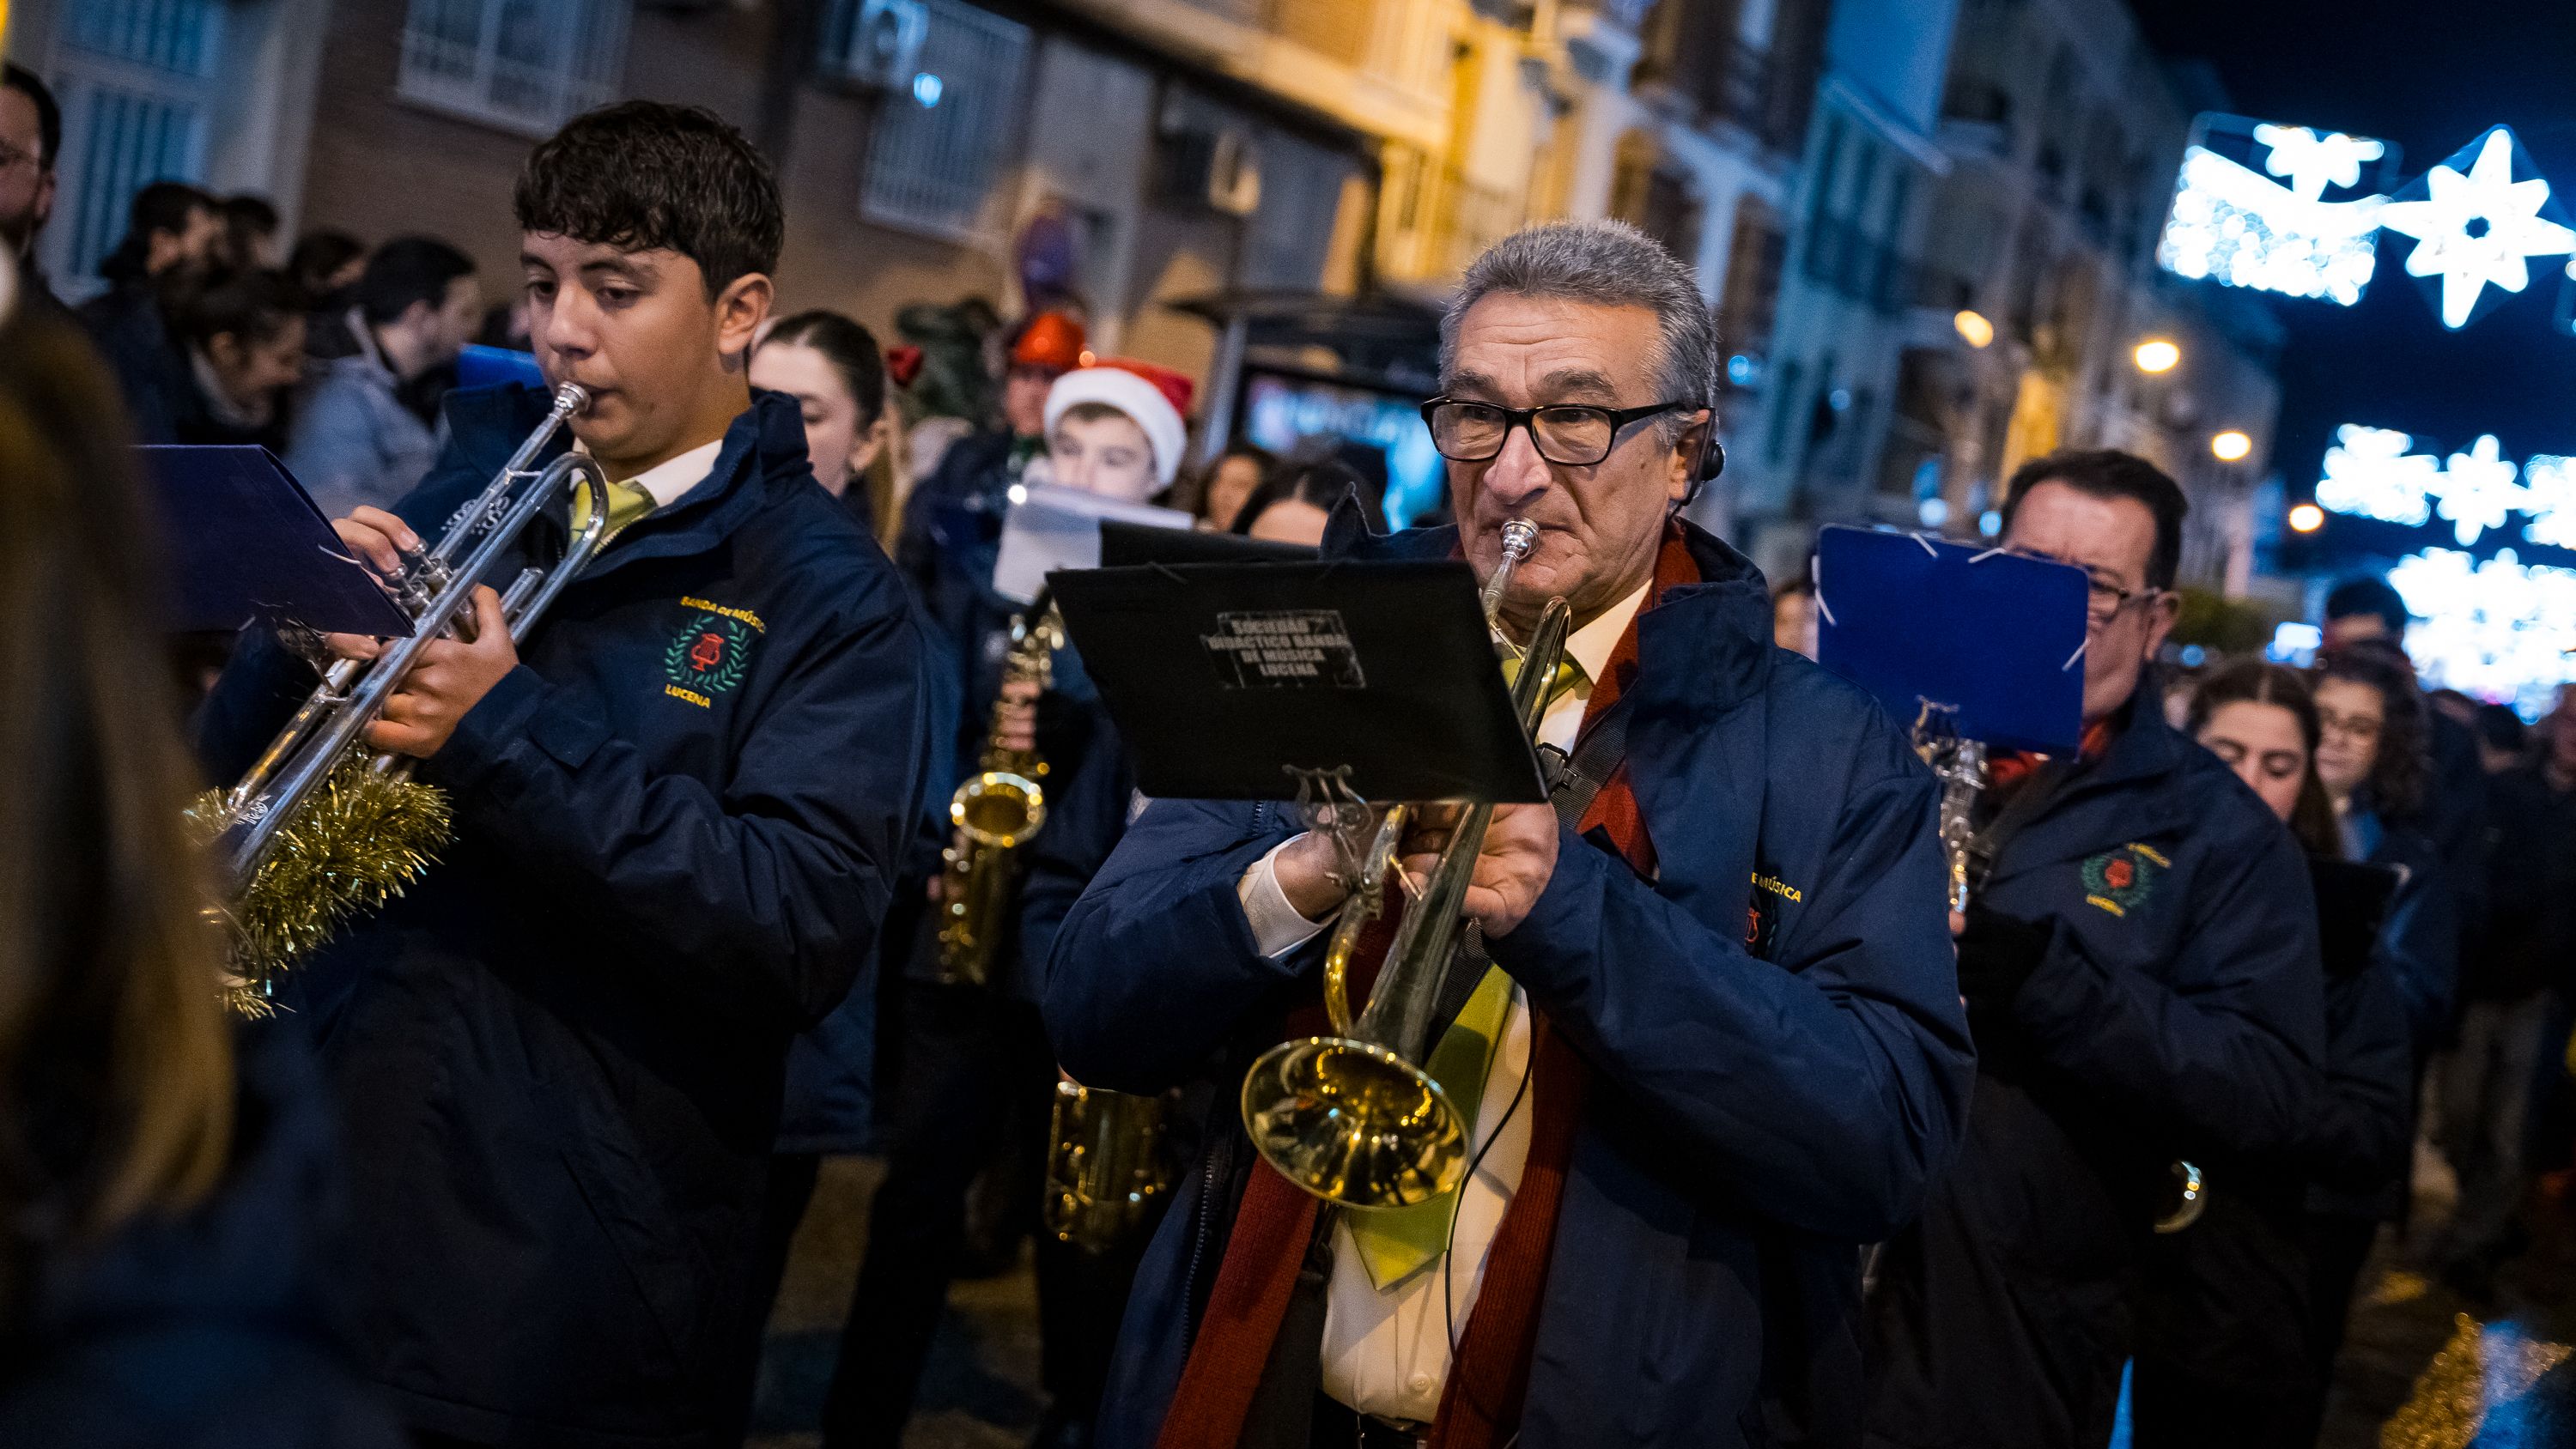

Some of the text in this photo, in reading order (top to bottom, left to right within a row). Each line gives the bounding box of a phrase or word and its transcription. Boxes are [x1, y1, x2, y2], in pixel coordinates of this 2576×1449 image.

[680, 596, 717, 612] BANDA
[731, 610, 767, 634] MÚSIC
[665, 683, 711, 709] LUCENA
[1758, 876, 1801, 903] MÚSICA
